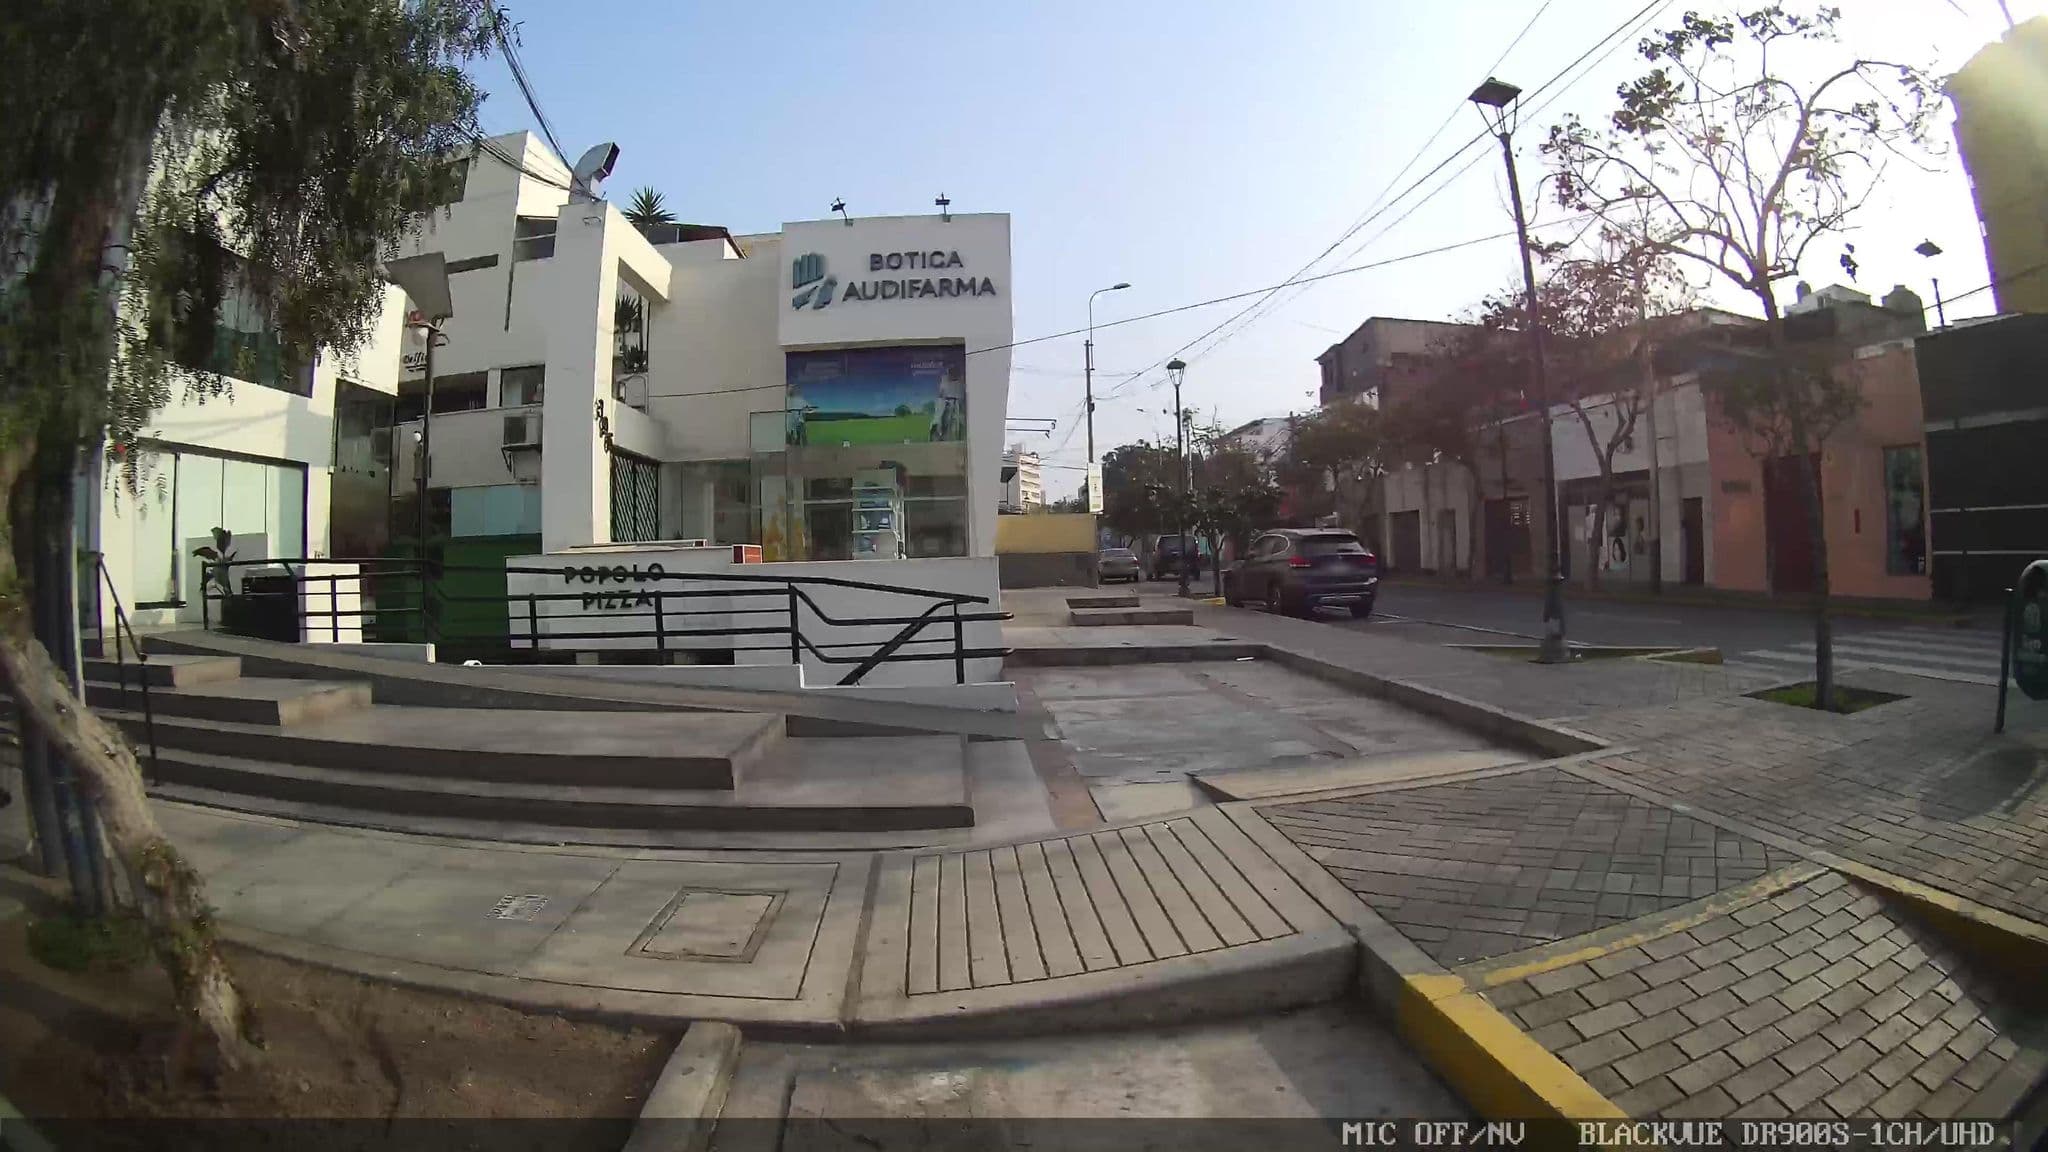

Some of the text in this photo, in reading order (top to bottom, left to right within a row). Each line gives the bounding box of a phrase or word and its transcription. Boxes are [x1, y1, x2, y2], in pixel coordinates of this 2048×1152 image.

[870, 251, 964, 272] BOTICA
[842, 277, 997, 302] AUDIFARMA
[564, 562, 665, 584] POPOLO
[582, 588, 653, 610] PIZZA
